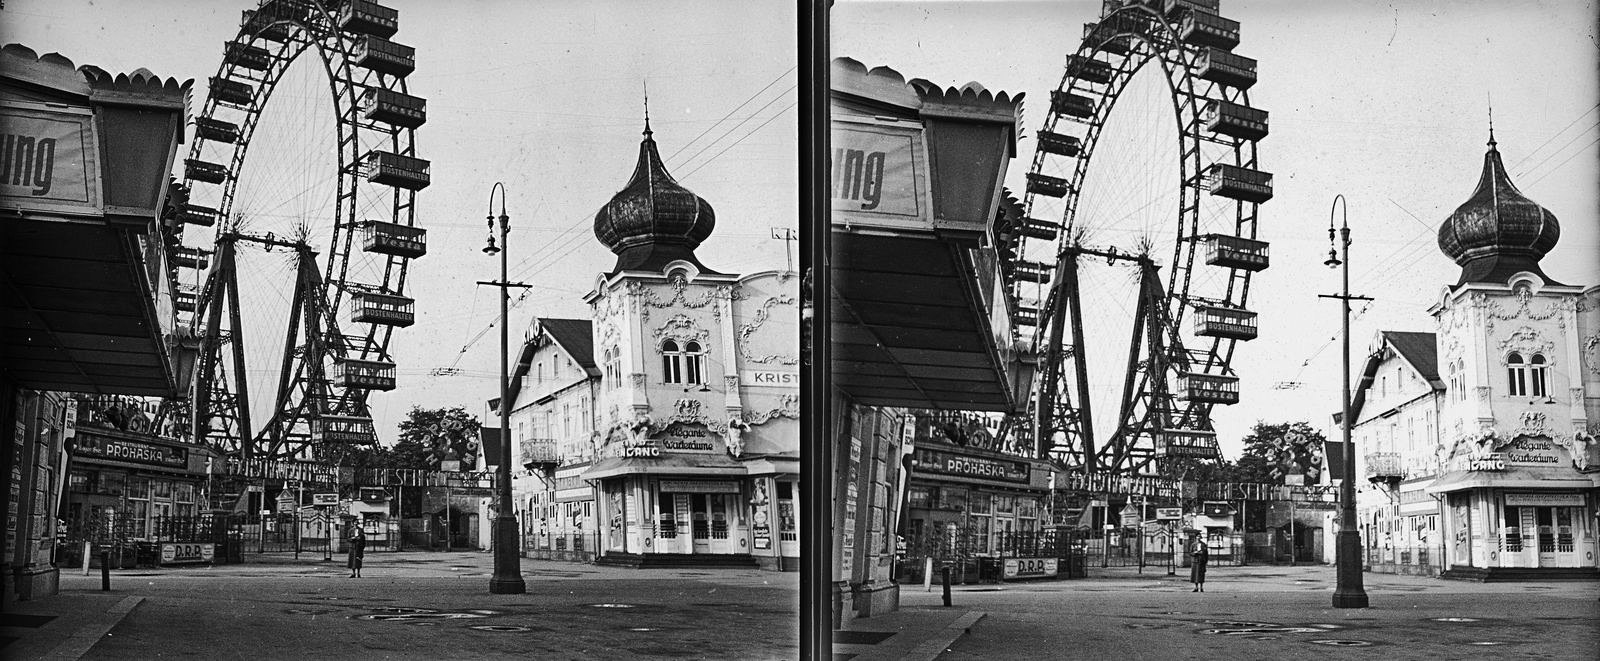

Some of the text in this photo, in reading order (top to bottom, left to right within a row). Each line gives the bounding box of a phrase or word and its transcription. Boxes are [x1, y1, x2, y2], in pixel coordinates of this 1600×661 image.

[382, 103, 421, 118] Vesta
[381, 237, 421, 250] Vesta
[1223, 250, 1264, 264] Vesta
[351, 375, 391, 386] Vesta
[1194, 389, 1234, 400] Vesta
[106, 443, 163, 462] PROHASKA
[947, 459, 1005, 478] PROHASKA
